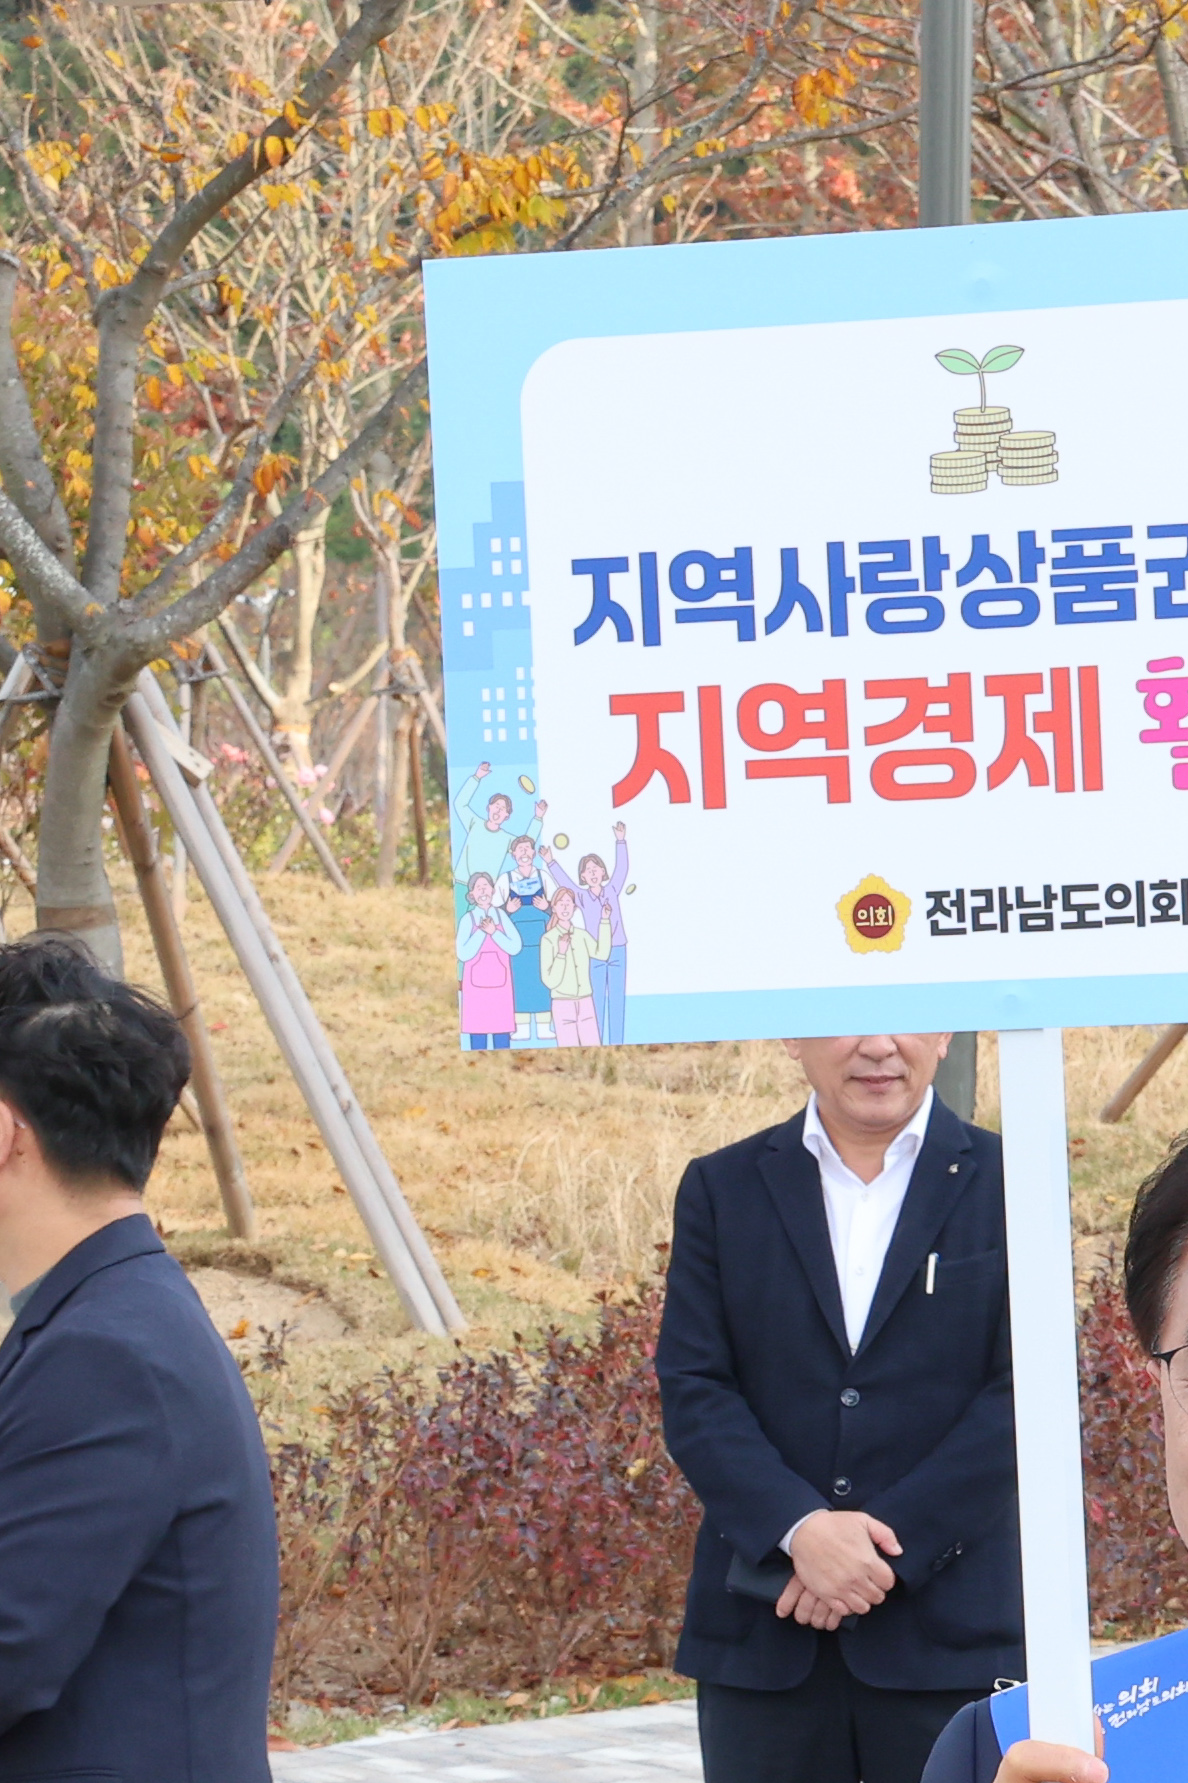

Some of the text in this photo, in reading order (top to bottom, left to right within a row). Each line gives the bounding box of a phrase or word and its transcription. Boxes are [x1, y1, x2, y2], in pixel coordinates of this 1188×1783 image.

[608, 664, 1105, 811] 지역경제
[855, 904, 893, 927] 의회
[1118, 1676, 1160, 1707] 의회
